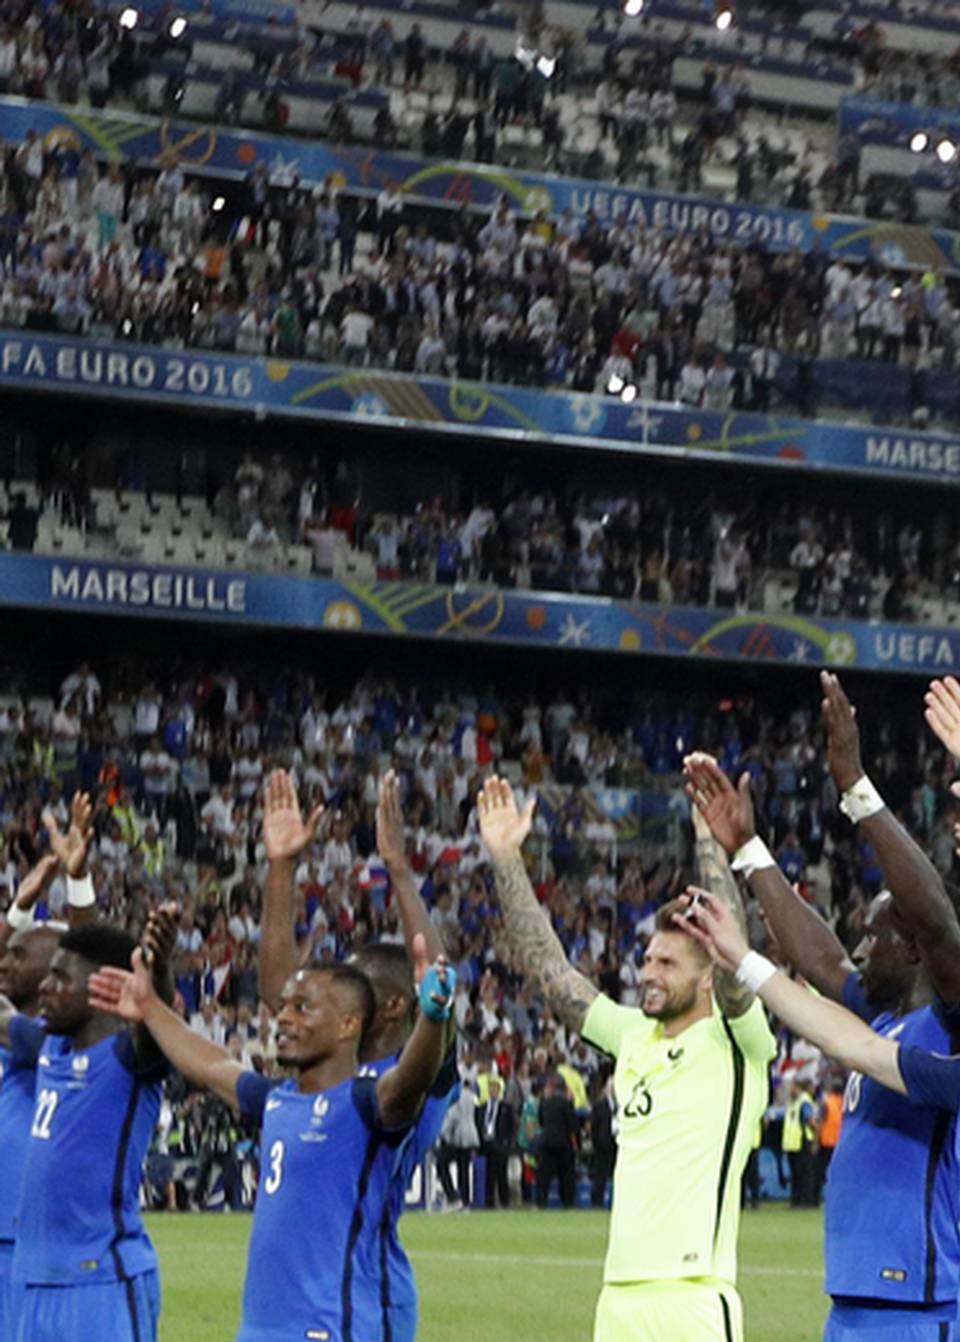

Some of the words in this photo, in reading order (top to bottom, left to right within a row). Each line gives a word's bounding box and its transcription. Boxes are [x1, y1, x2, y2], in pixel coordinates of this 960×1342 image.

[652, 200, 731, 235] EURO
[736, 207, 805, 244] 2016
[57, 348, 155, 387] EURO
[165, 359, 252, 397] 2016
[52, 565, 246, 612] MARSEILLE
[875, 633, 953, 664] UEFA
[265, 1140, 284, 1194] 3
